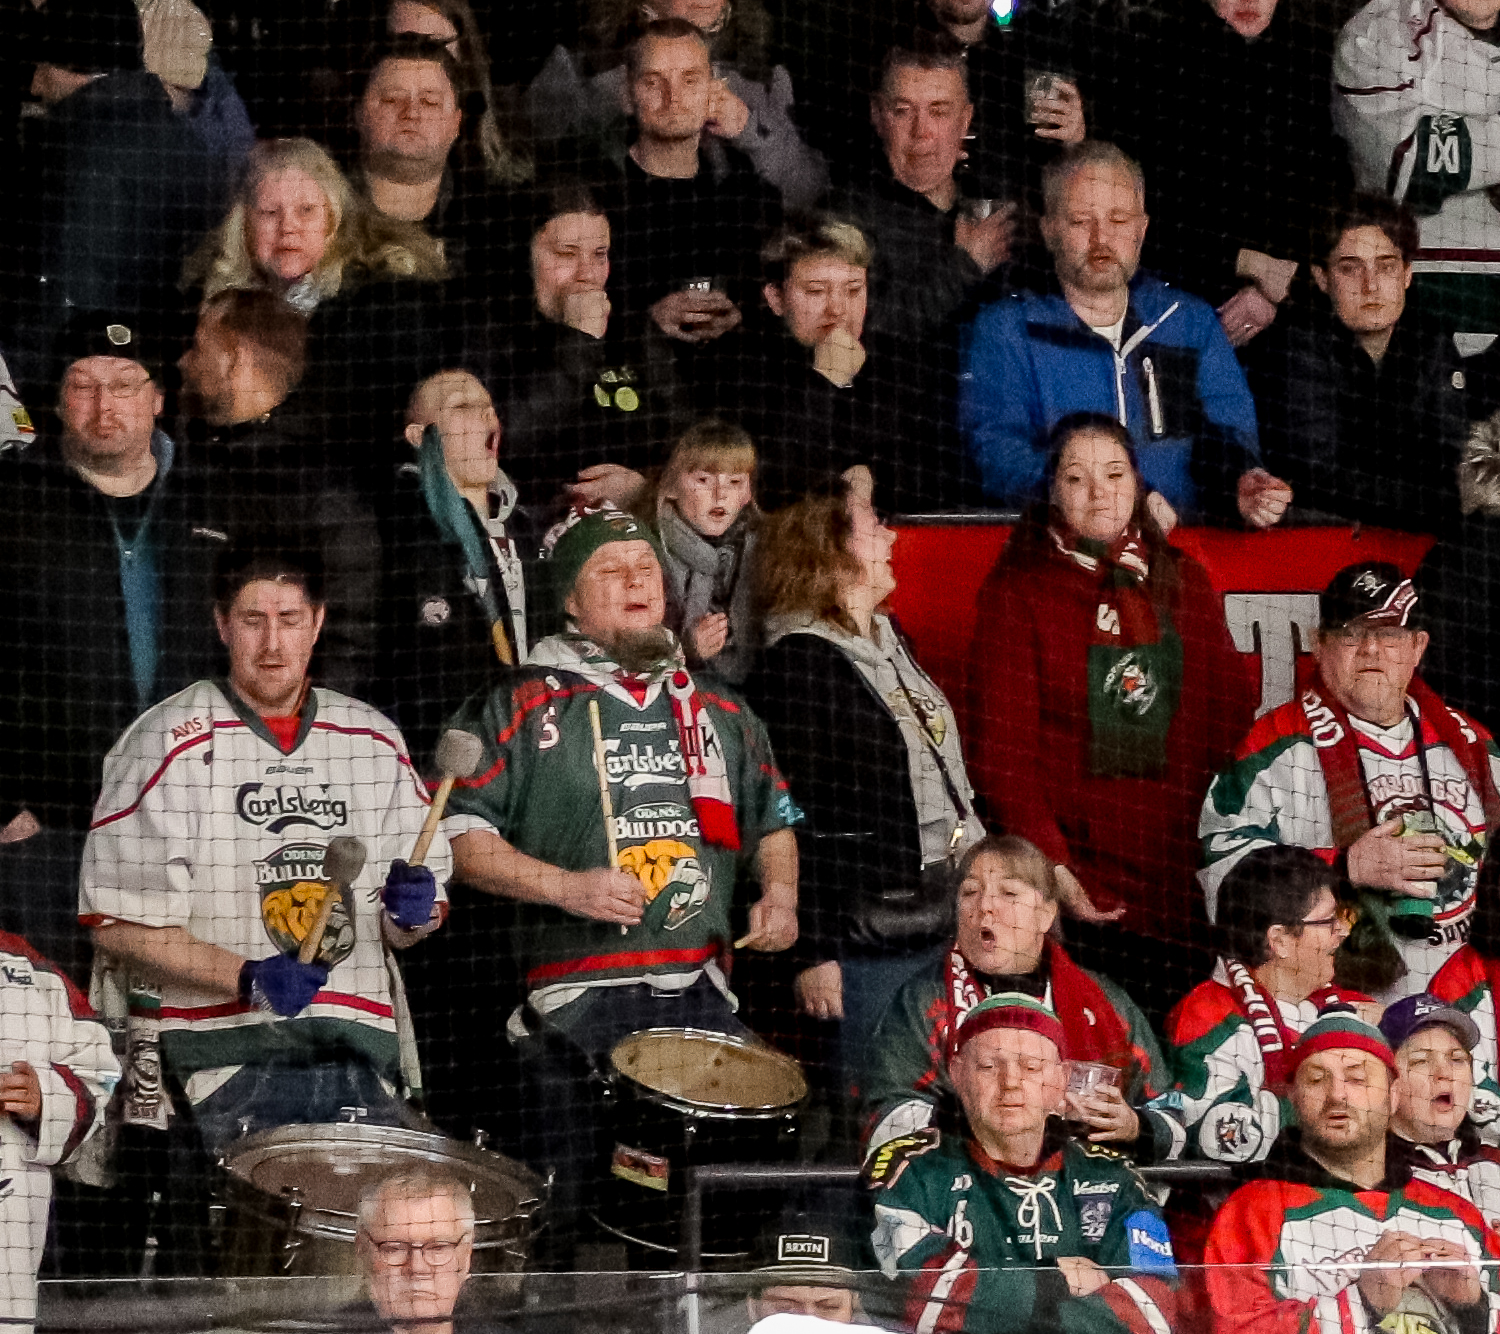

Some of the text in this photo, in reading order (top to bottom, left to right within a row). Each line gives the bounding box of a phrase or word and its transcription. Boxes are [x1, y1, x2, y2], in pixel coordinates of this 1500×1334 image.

[235, 782, 349, 831] Carlsberg
[613, 815, 700, 840] BULLDOG
[1130, 1228, 1174, 1258] Nord
